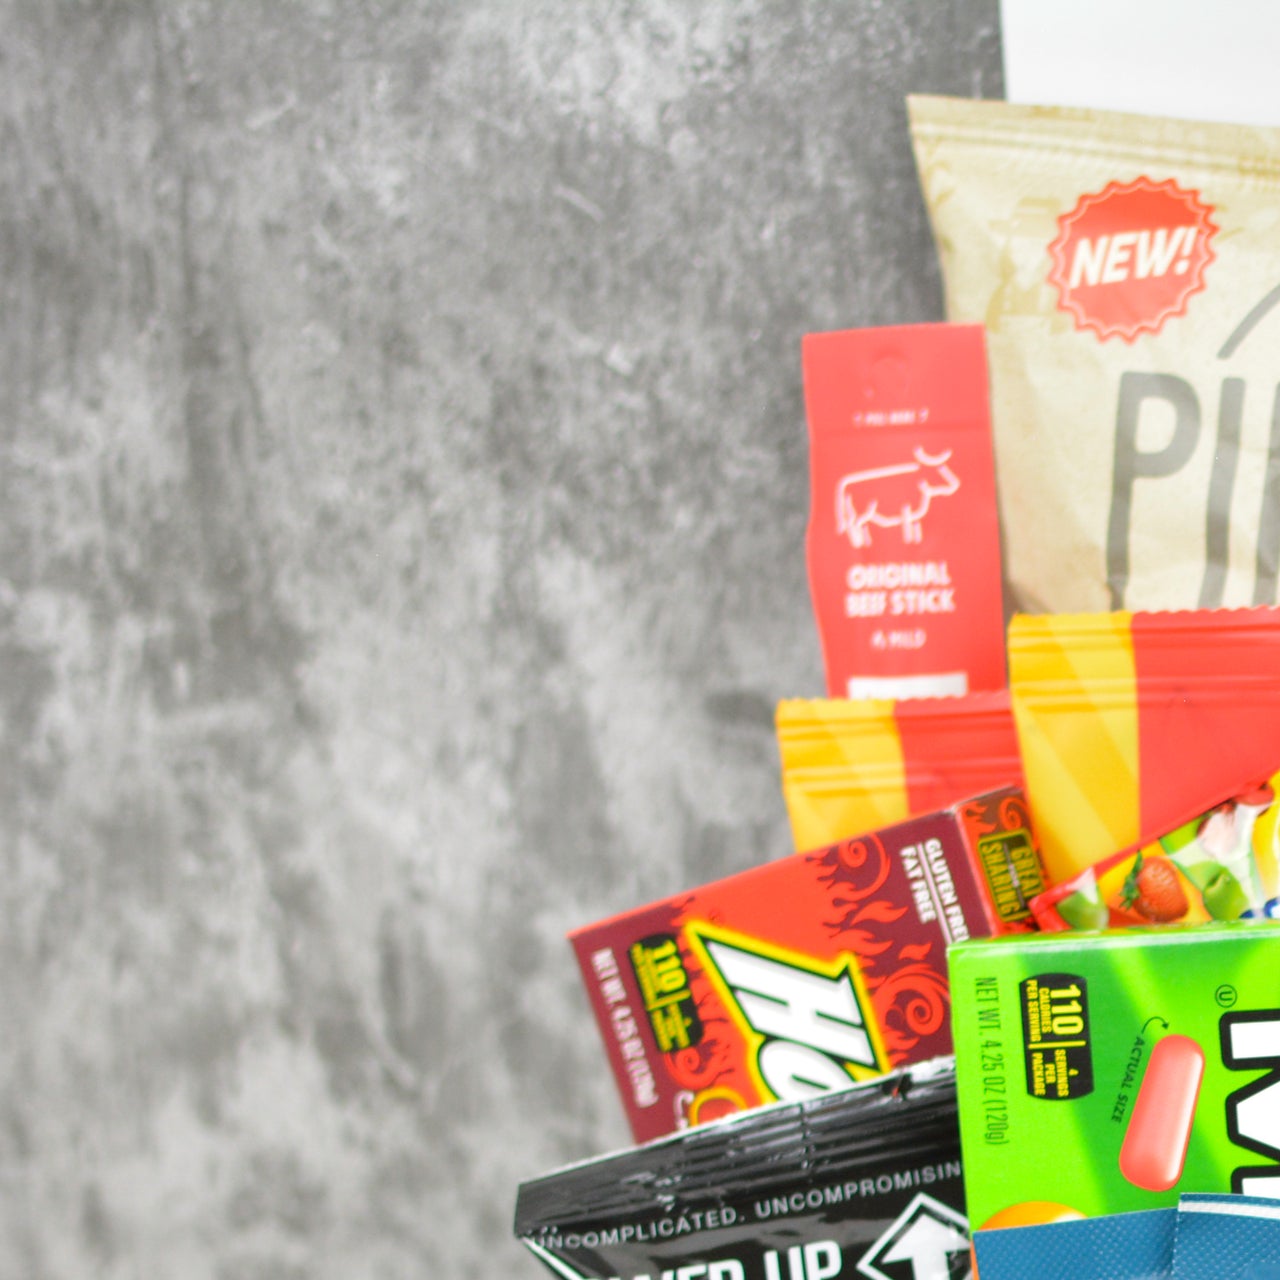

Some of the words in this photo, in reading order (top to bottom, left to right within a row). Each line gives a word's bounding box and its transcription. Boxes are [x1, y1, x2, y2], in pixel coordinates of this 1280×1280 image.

[1070, 226, 1198, 290] NEW!
[900, 845, 924, 879] FAT
[925, 838, 958, 906] GLUTEN
[910, 880, 937, 924] FREE
[976, 976, 999, 1003] NET
[1026, 979, 1039, 1000] PER
[1039, 987, 1052, 1034] CALORIES
[1050, 983, 1085, 1035] 110
[978, 1007, 1002, 1037] WT.
[981, 1039, 1005, 1073] 4.25
[1032, 1053, 1046, 1097] PACKAGE
[1045, 1063, 1056, 1084] PER
[1055, 1049, 1070, 1098] SERVINGS
[1122, 1036, 1145, 1089] ACTUAL
[983, 1076, 1007, 1095] OZ
[982, 1099, 1010, 1146] (120g)
[1111, 1093, 1129, 1124] SIZE
[756, 1161, 964, 1218] UNCOMPROMISIN
